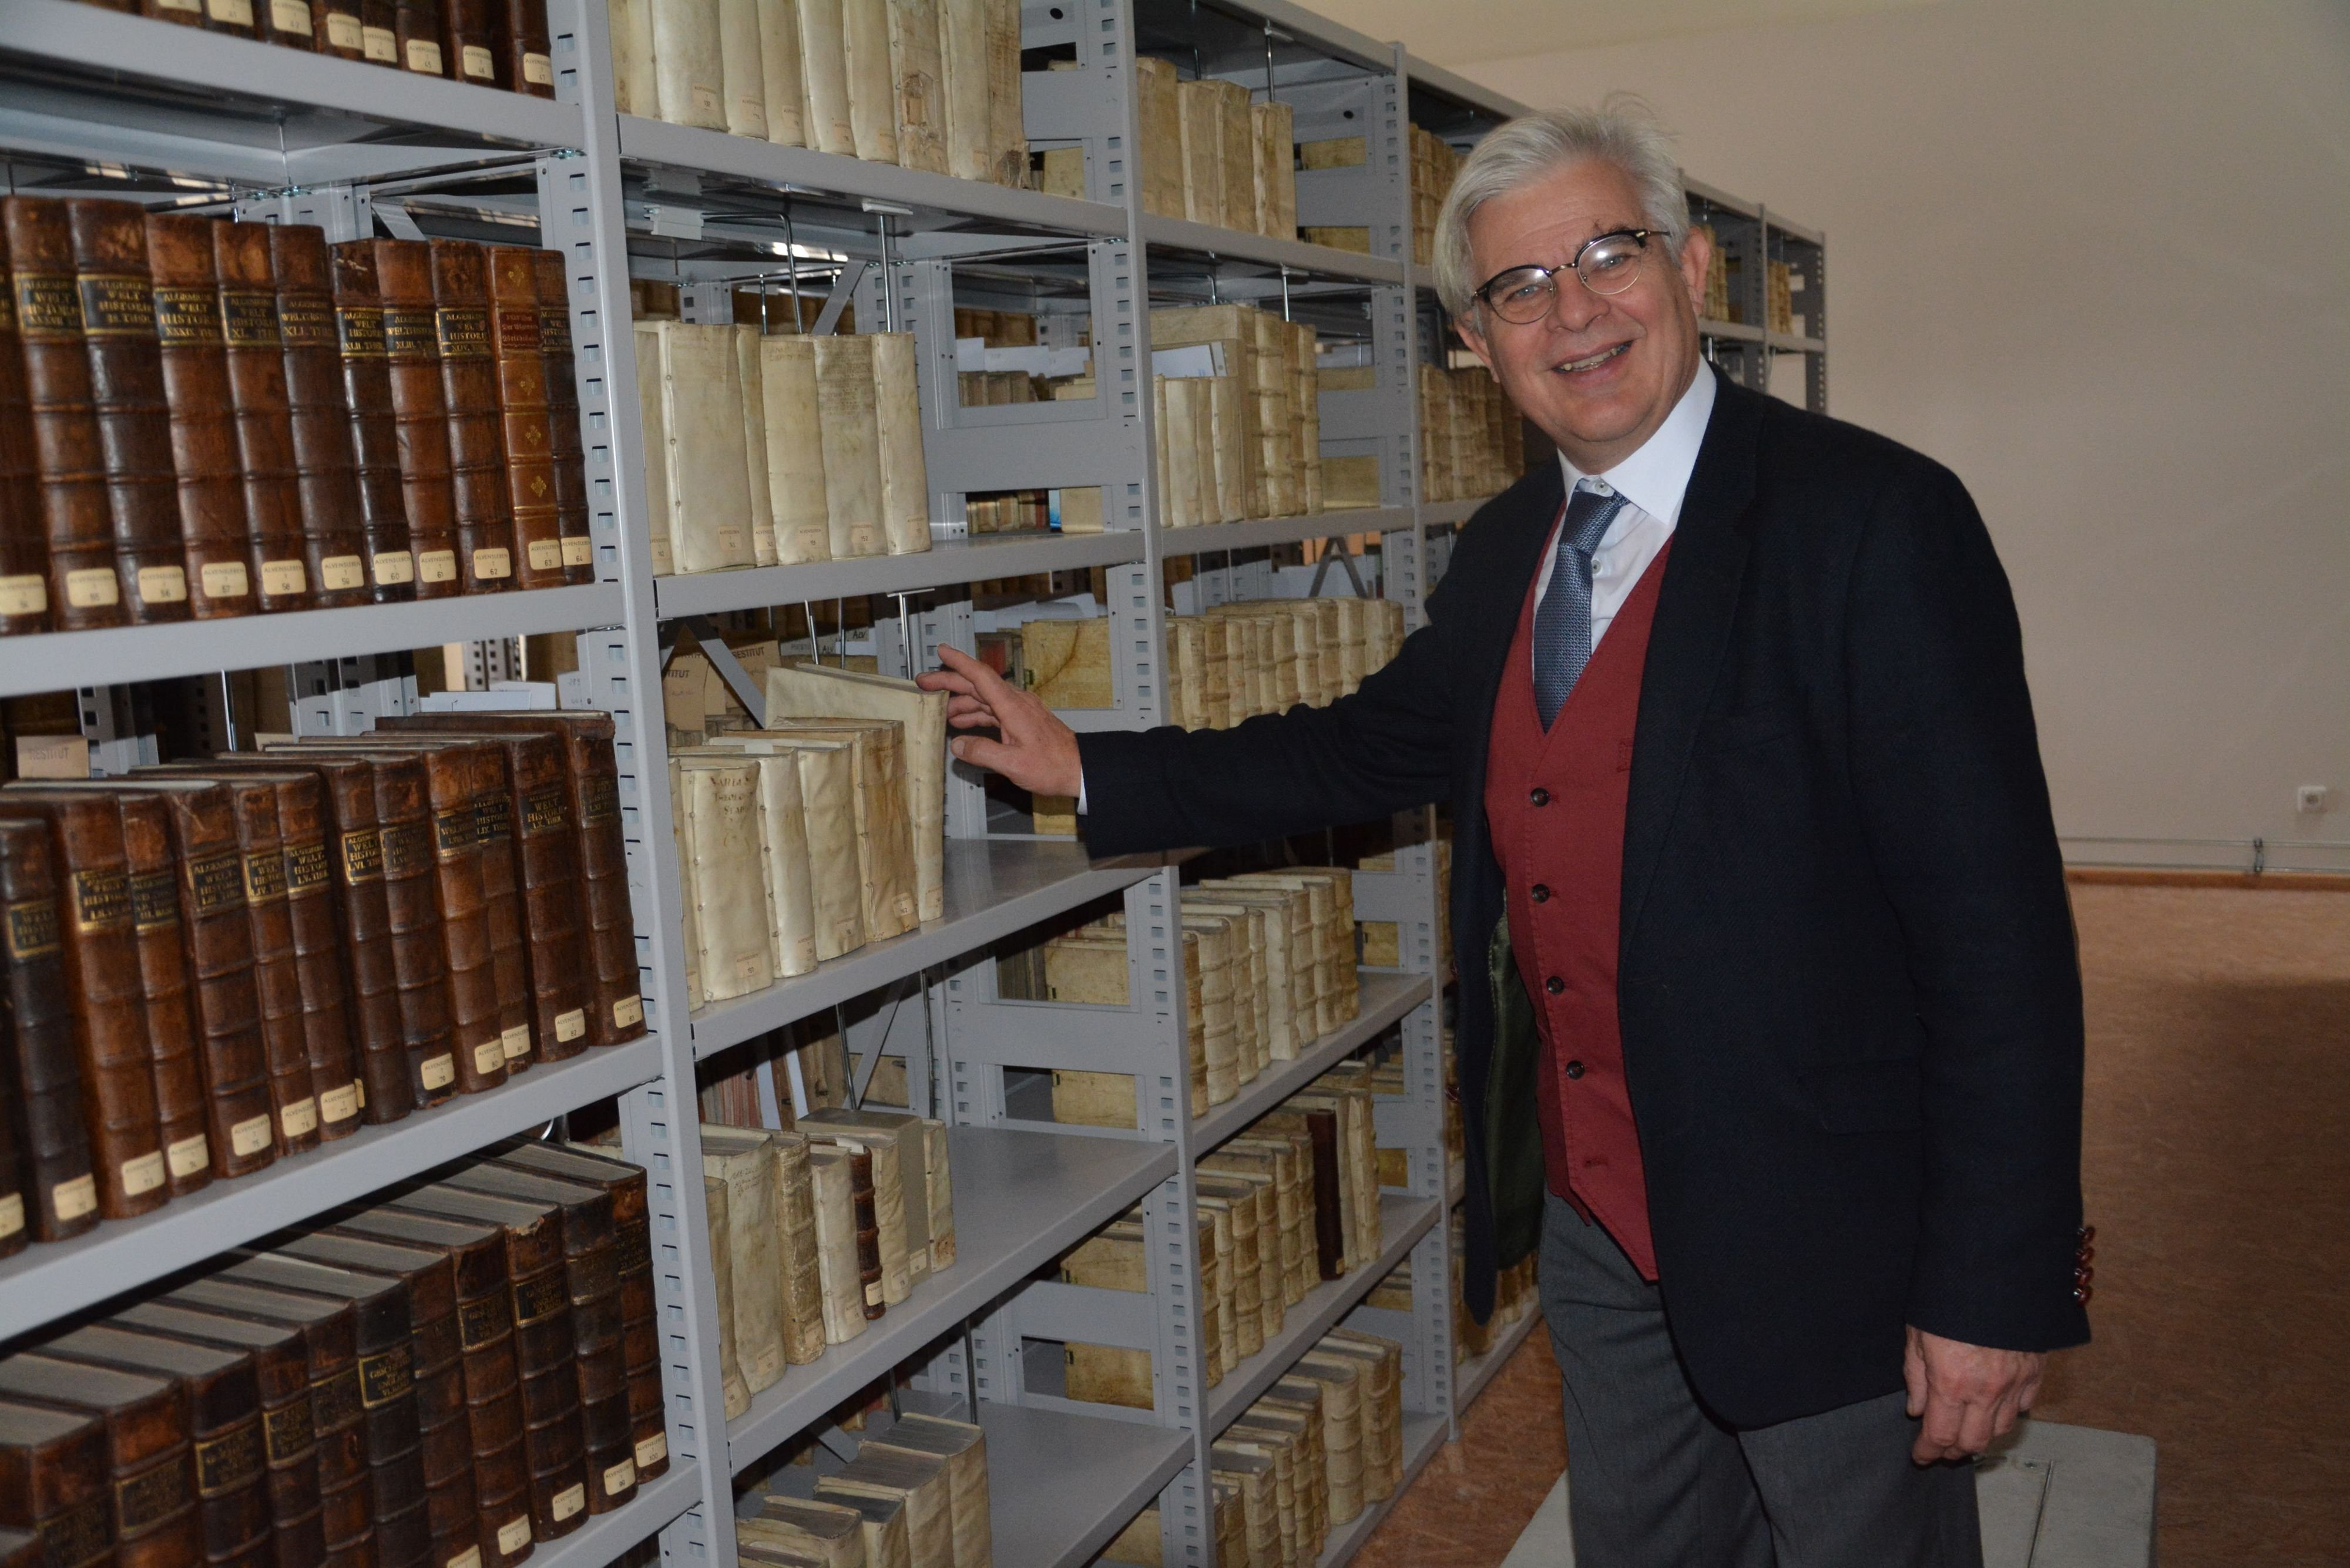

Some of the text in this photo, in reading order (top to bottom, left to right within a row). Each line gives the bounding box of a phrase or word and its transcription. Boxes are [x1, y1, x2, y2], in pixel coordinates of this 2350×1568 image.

[543, 559, 553, 567] 63
[390, 572, 400, 581] 60
[489, 568, 498, 576] 62
[535, 798, 559, 812] WELT
[649, 1452, 659, 1462] 100
